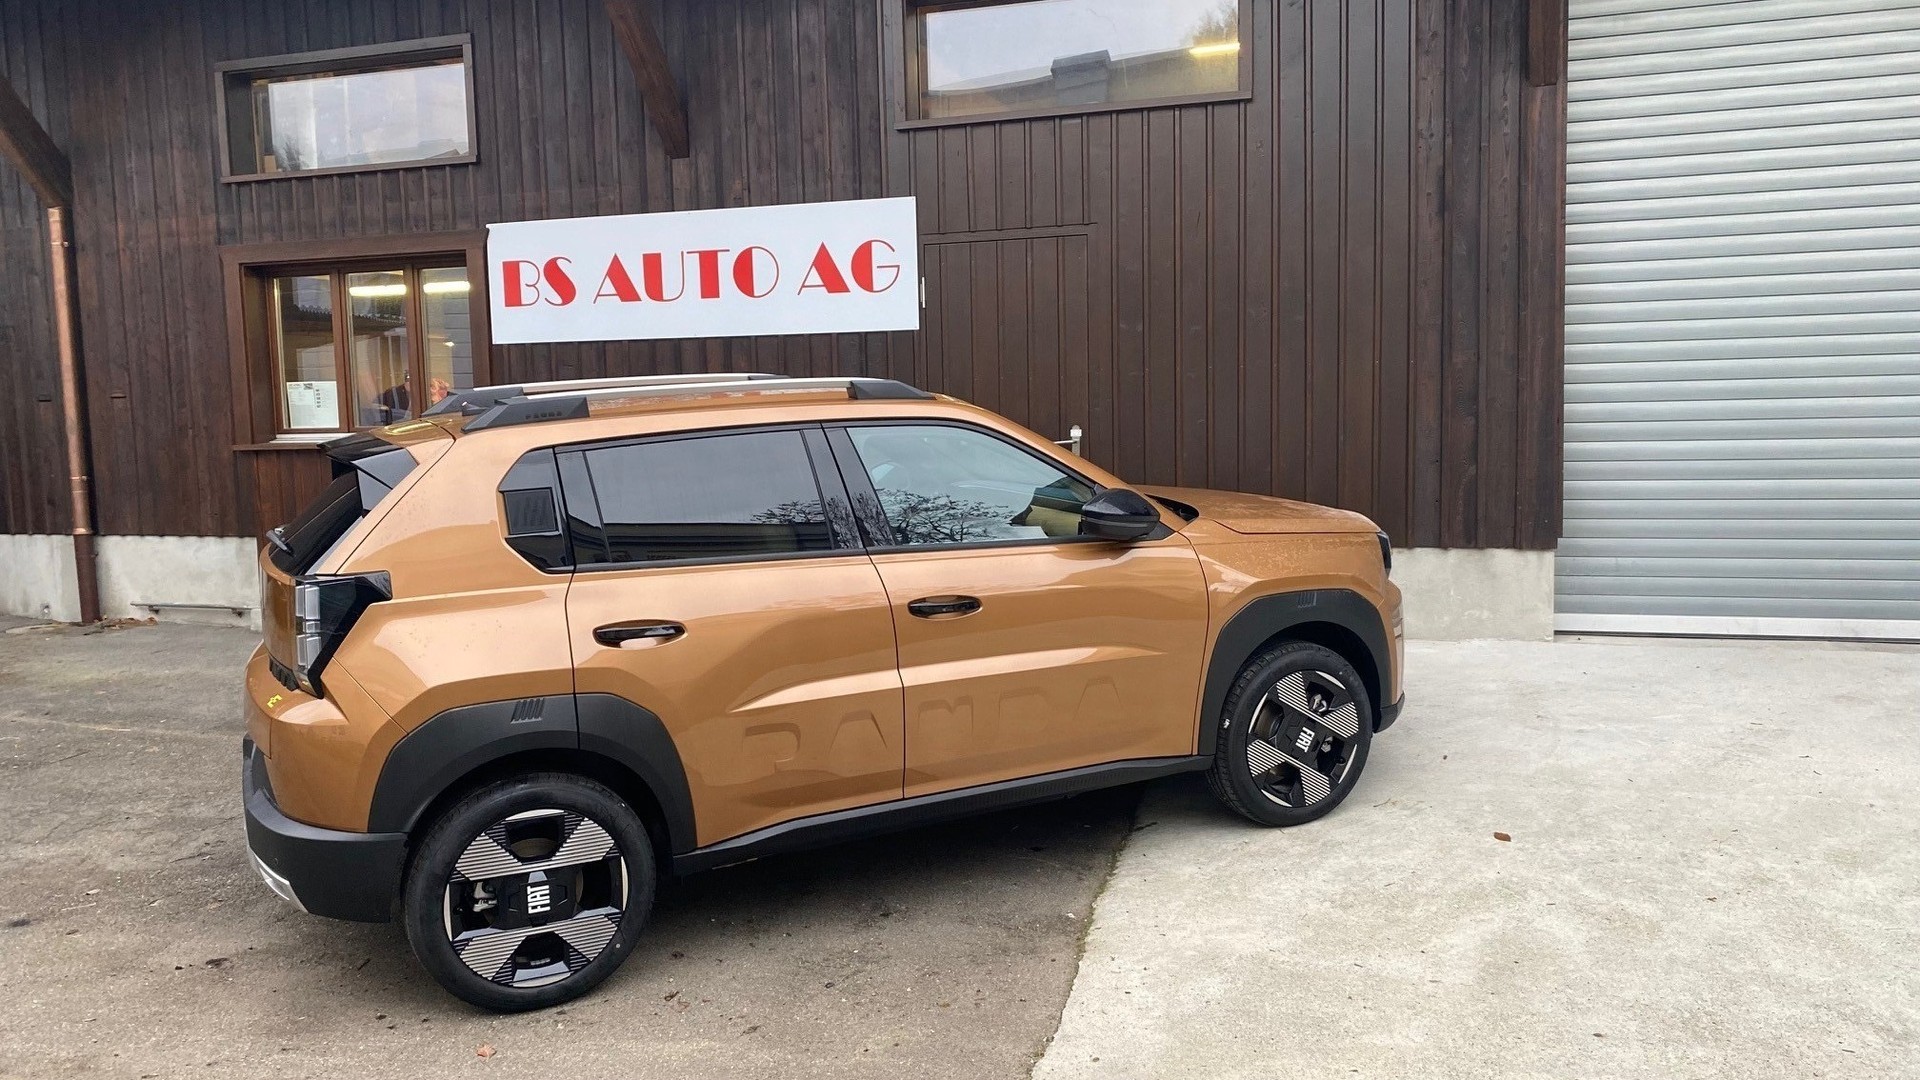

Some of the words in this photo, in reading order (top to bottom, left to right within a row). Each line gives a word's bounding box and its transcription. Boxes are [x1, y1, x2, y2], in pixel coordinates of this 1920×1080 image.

[502, 256, 577, 308] BS
[593, 245, 780, 304] AUTO
[797, 239, 900, 296] AG
[1295, 726, 1315, 753] FIAT
[526, 885, 551, 914] FIAT
